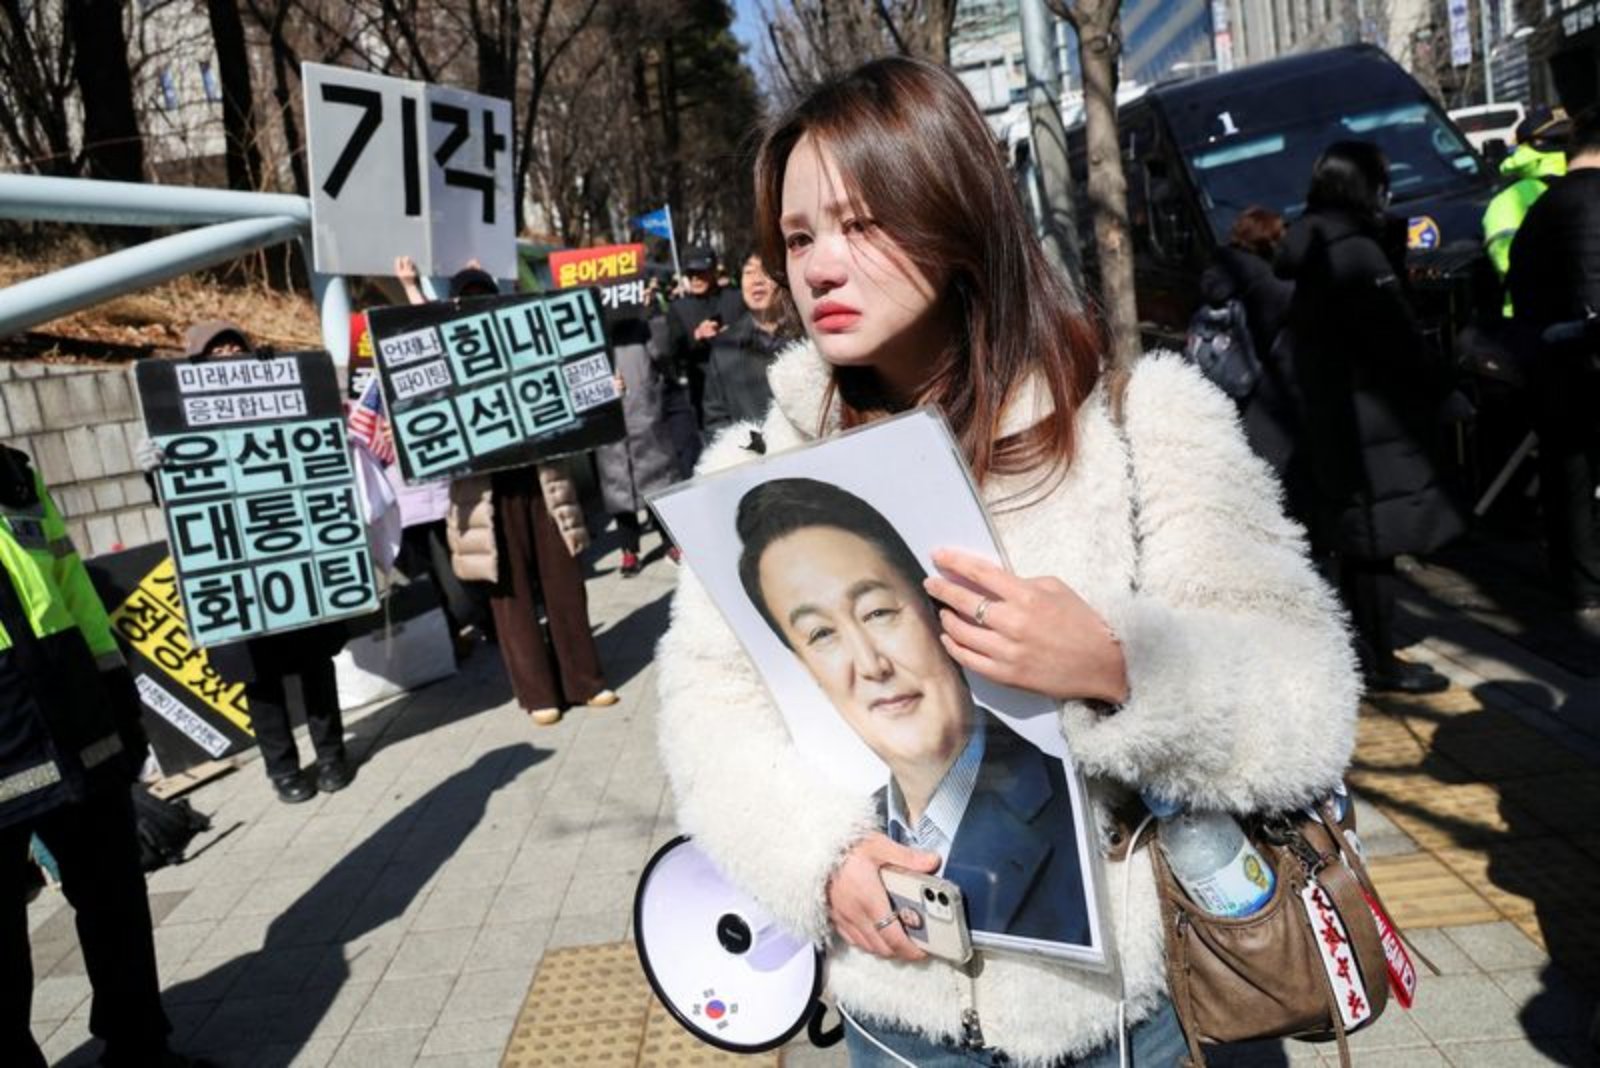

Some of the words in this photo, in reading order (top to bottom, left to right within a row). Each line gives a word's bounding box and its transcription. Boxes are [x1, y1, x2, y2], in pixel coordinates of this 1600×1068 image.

[1218, 111, 1239, 136] 1
[319, 82, 506, 224] 기각
[560, 250, 637, 288] 윤어게인
[384, 332, 438, 363] 언제나
[449, 294, 598, 378] 힘내라
[181, 363, 295, 387] 미래세대가
[399, 364, 450, 393] 파이팅
[188, 393, 303, 423] 응원합니다
[407, 371, 568, 468] 윤석열
[162, 421, 350, 495] 윤석열
[175, 487, 361, 562] 대통령
[191, 550, 373, 632] 화이팅
